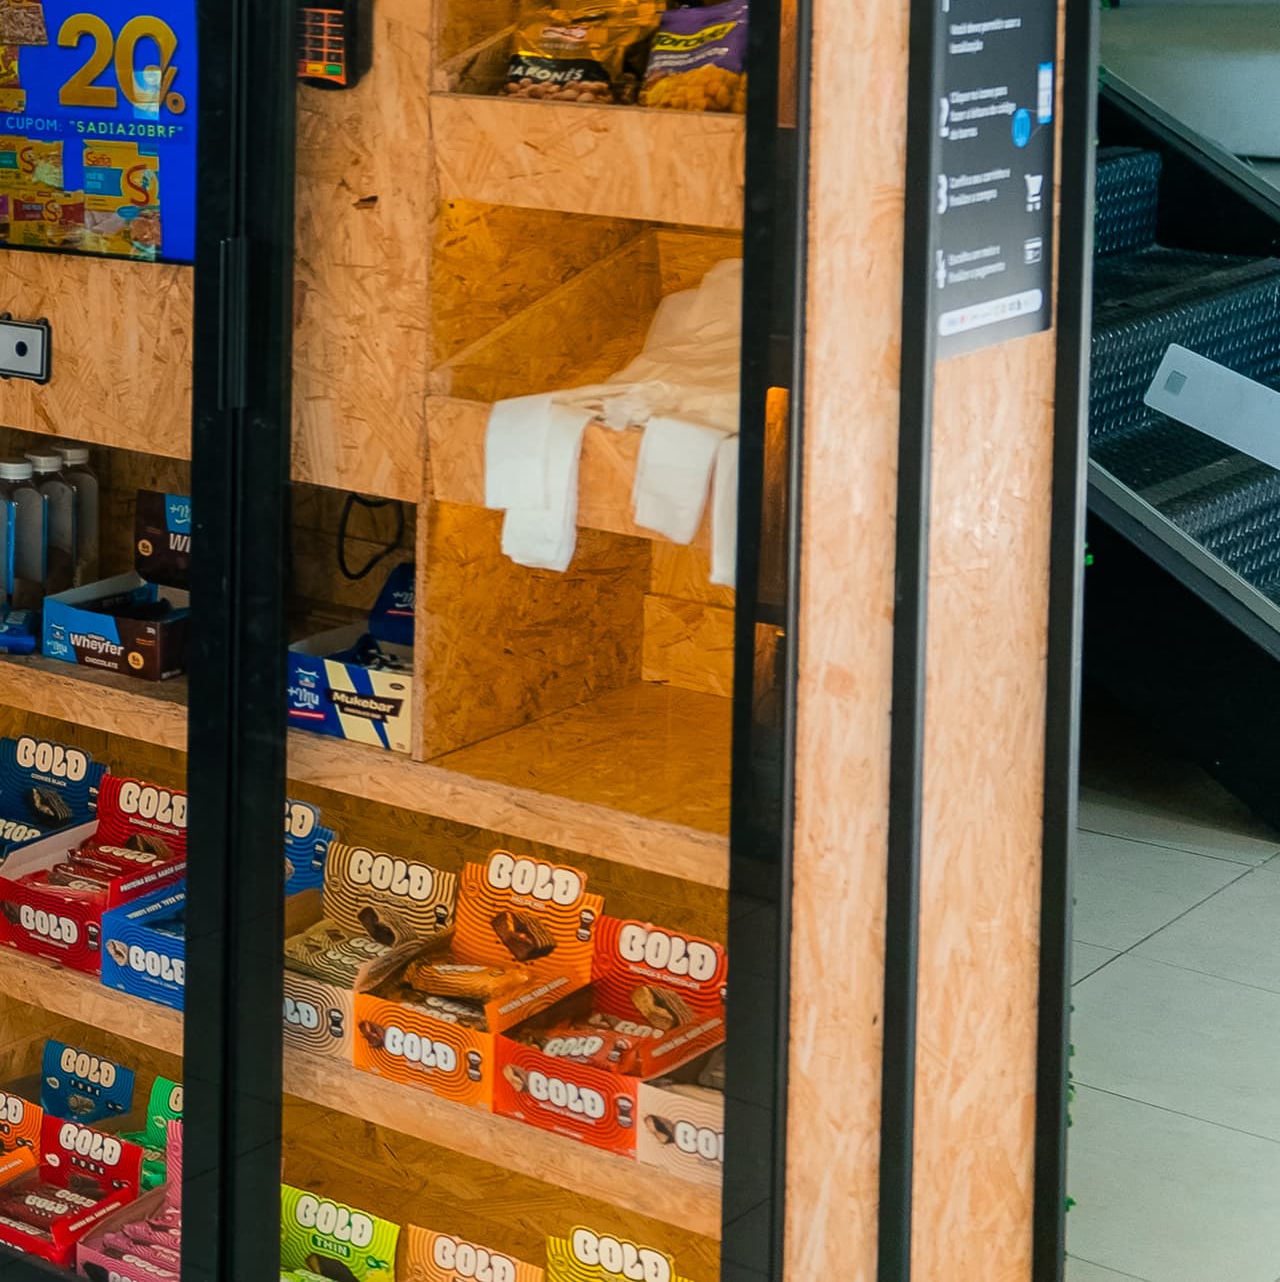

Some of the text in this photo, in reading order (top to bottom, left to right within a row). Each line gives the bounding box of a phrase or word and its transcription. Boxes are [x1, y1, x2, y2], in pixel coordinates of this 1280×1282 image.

[5, 116, 63, 133] CUPOM:
[68, 632, 125, 657] Wheyfer
[331, 692, 396, 714] Mukebar
[15, 736, 88, 783] BOLD
[118, 780, 188, 829] BOLD
[348, 849, 434, 902] BOLD
[487, 852, 582, 906] BOLD
[19, 904, 79, 945] BOLD
[618, 923, 718, 983] BOLD
[59, 1046, 117, 1089] BOLD
[383, 1024, 458, 1073] BOLD
[526, 1069, 607, 1120] BOLD
[58, 1122, 123, 1167] BOLD
[295, 1194, 374, 1249] BOLD
[315, 1236, 349, 1258] THIN
[433, 1235, 517, 1282] BOLD
[572, 1227, 672, 1282] BOLD
